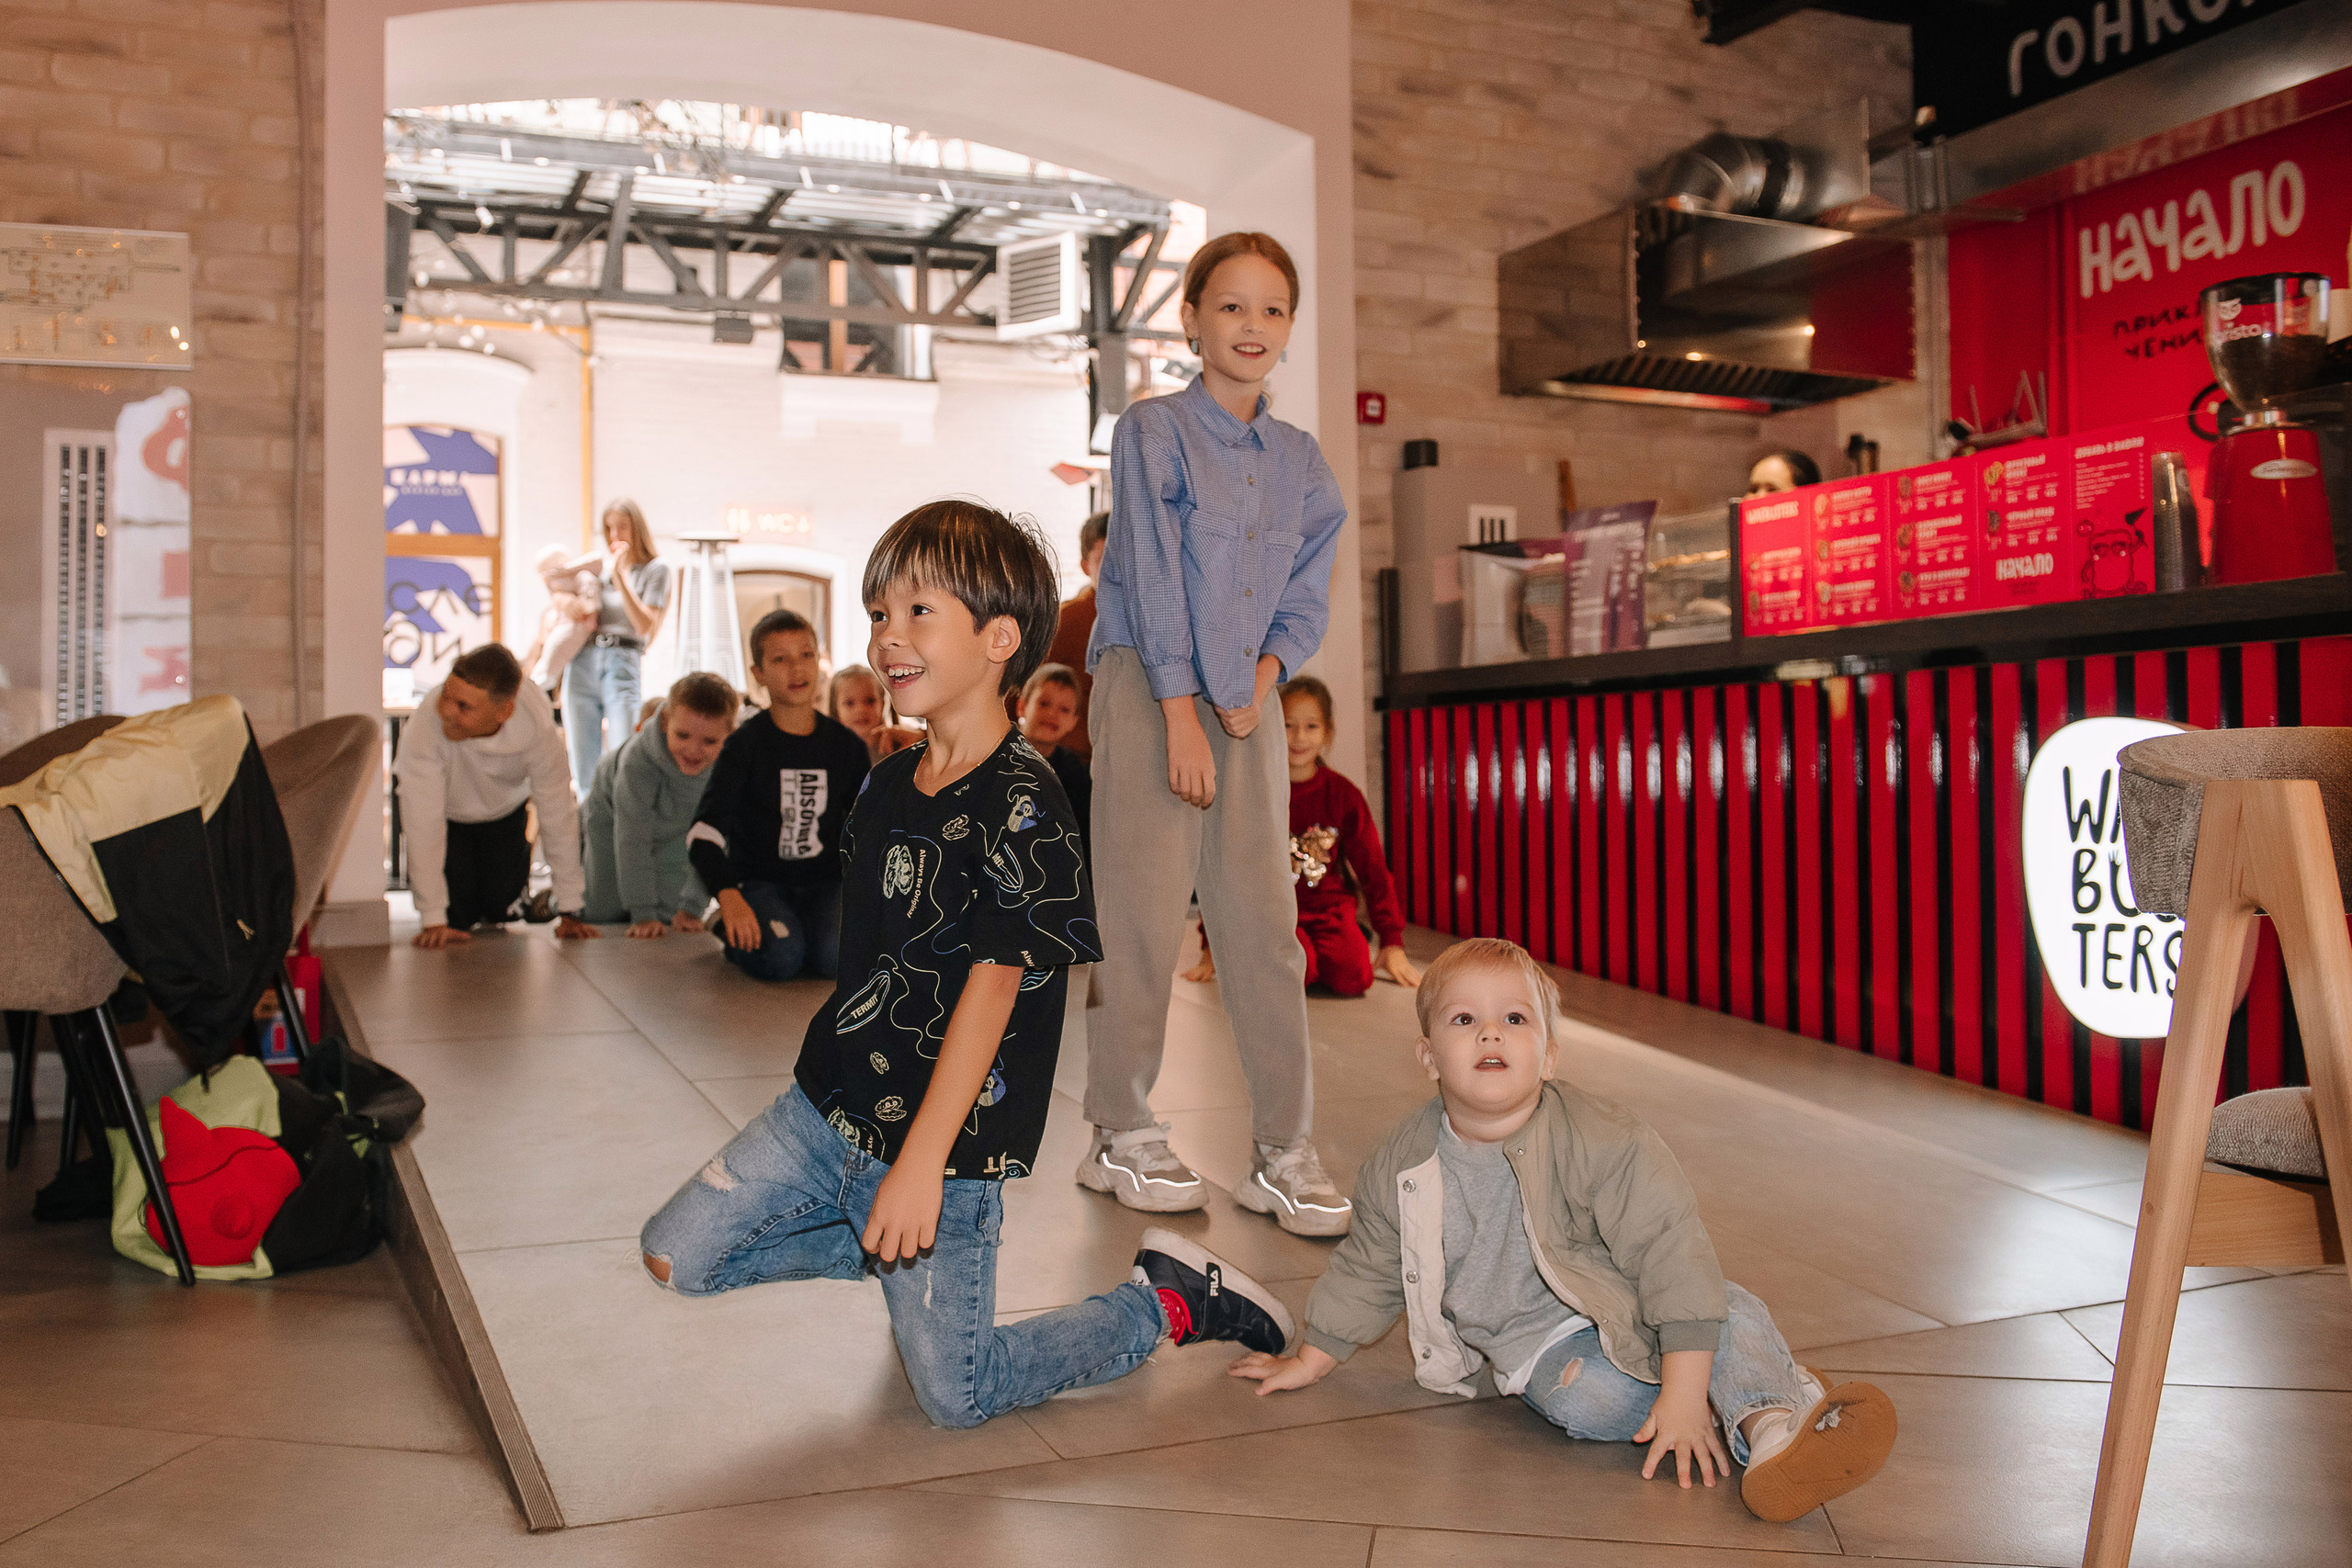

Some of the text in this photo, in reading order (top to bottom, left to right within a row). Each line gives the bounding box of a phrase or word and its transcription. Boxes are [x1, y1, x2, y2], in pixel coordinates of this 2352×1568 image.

[906, 849, 927, 919] Always Be Original
[2072, 847, 2178, 923] BU
[1020, 950, 1035, 967] Alw
[851, 993, 878, 1019] TERMIT
[1209, 1269, 1219, 1297] FILA
